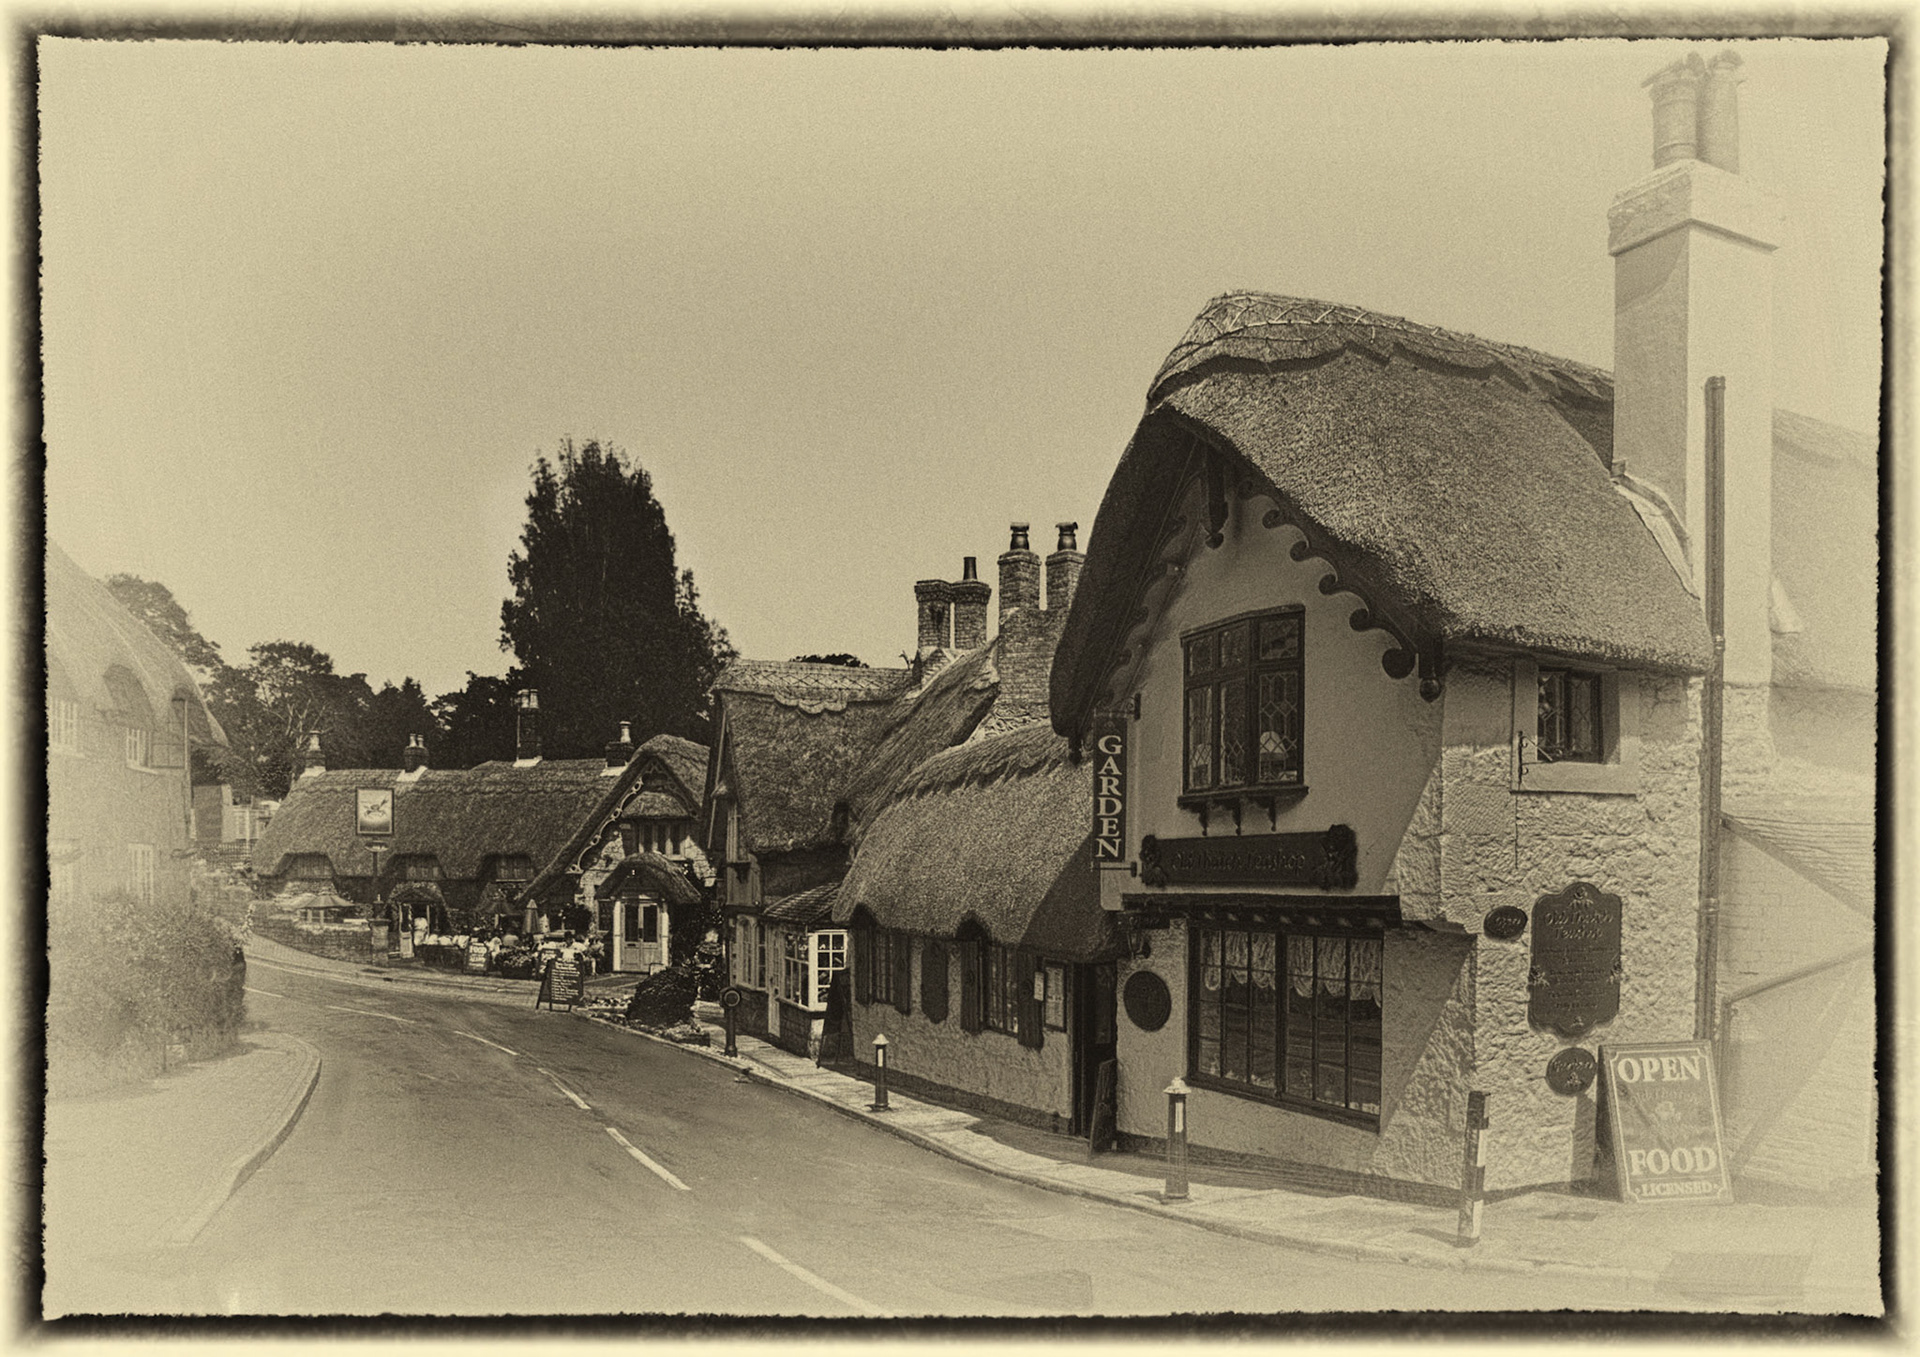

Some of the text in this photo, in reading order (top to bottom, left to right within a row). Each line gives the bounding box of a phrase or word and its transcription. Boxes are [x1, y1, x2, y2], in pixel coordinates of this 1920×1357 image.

[1095, 734, 1123, 858] GARDEN
[1617, 1055, 1701, 1083] OPEN
[1628, 1146, 1718, 1176] FOOD
[1641, 1181, 1713, 1197] LICENSED
